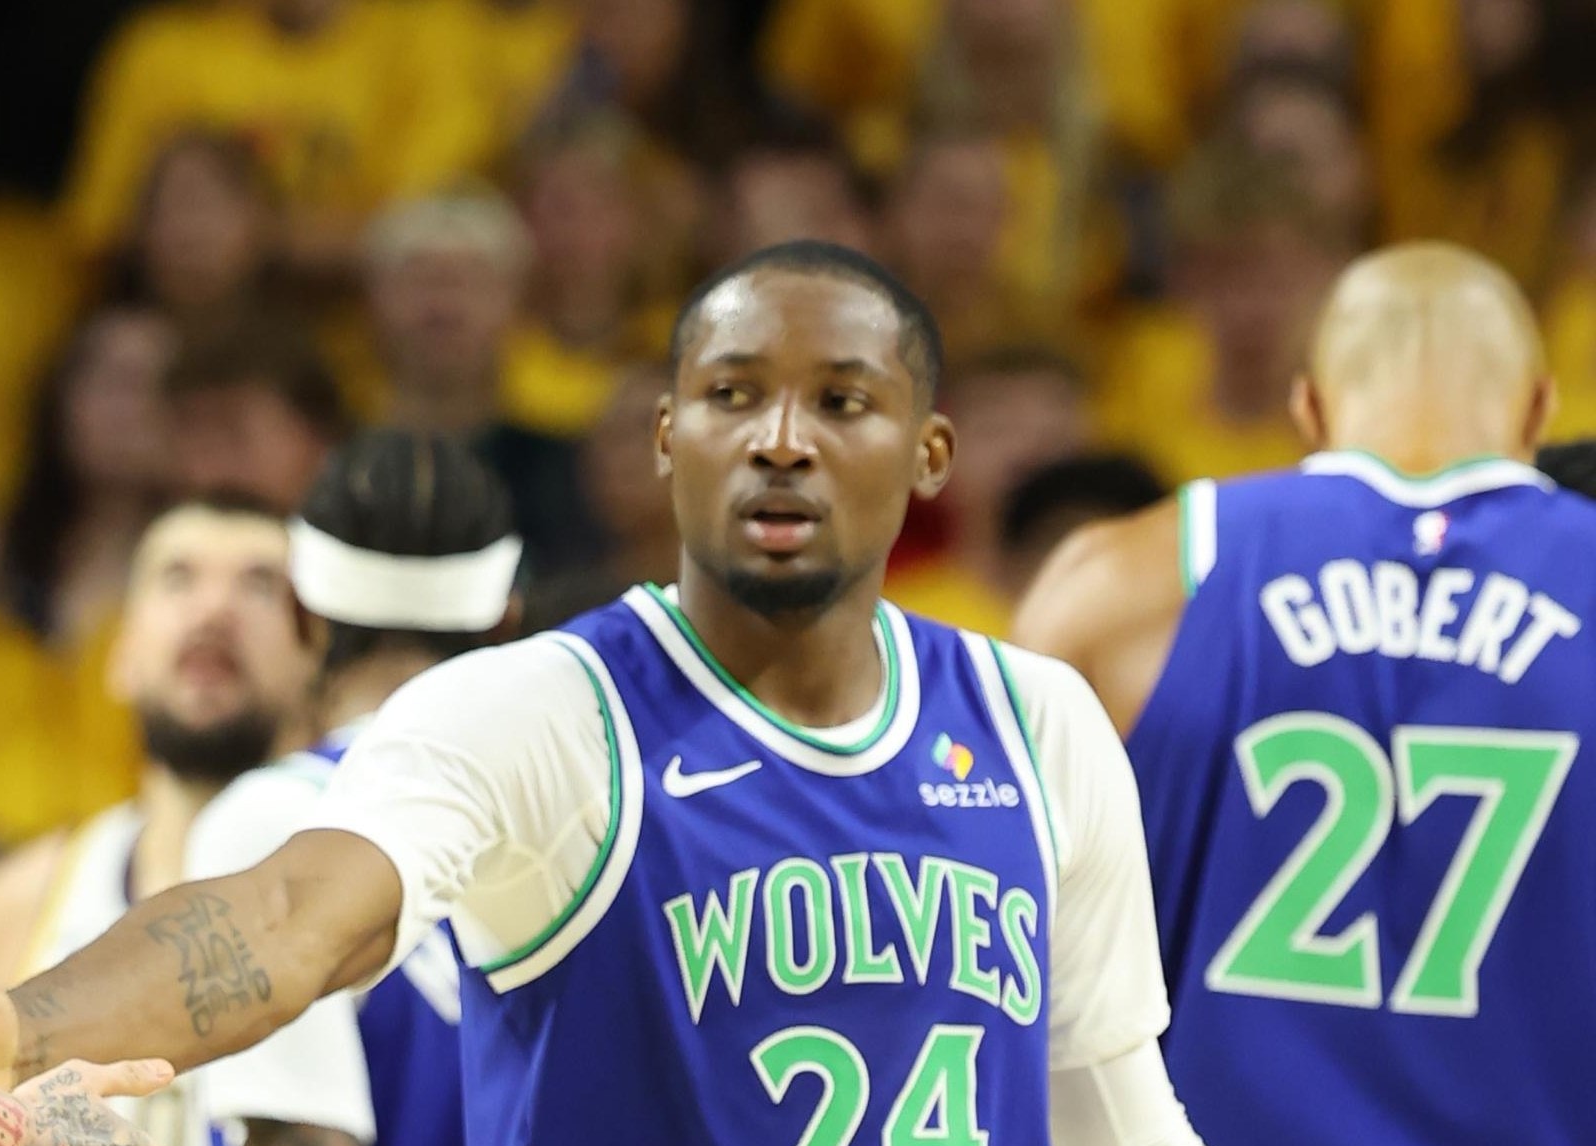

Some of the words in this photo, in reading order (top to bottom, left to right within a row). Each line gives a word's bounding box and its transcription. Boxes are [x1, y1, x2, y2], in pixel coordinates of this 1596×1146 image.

[1260, 558, 1581, 684] GOBERT
[918, 777, 1020, 808] sezzle
[1205, 709, 1580, 1018] 27
[662, 852, 1042, 1026] WOLVES
